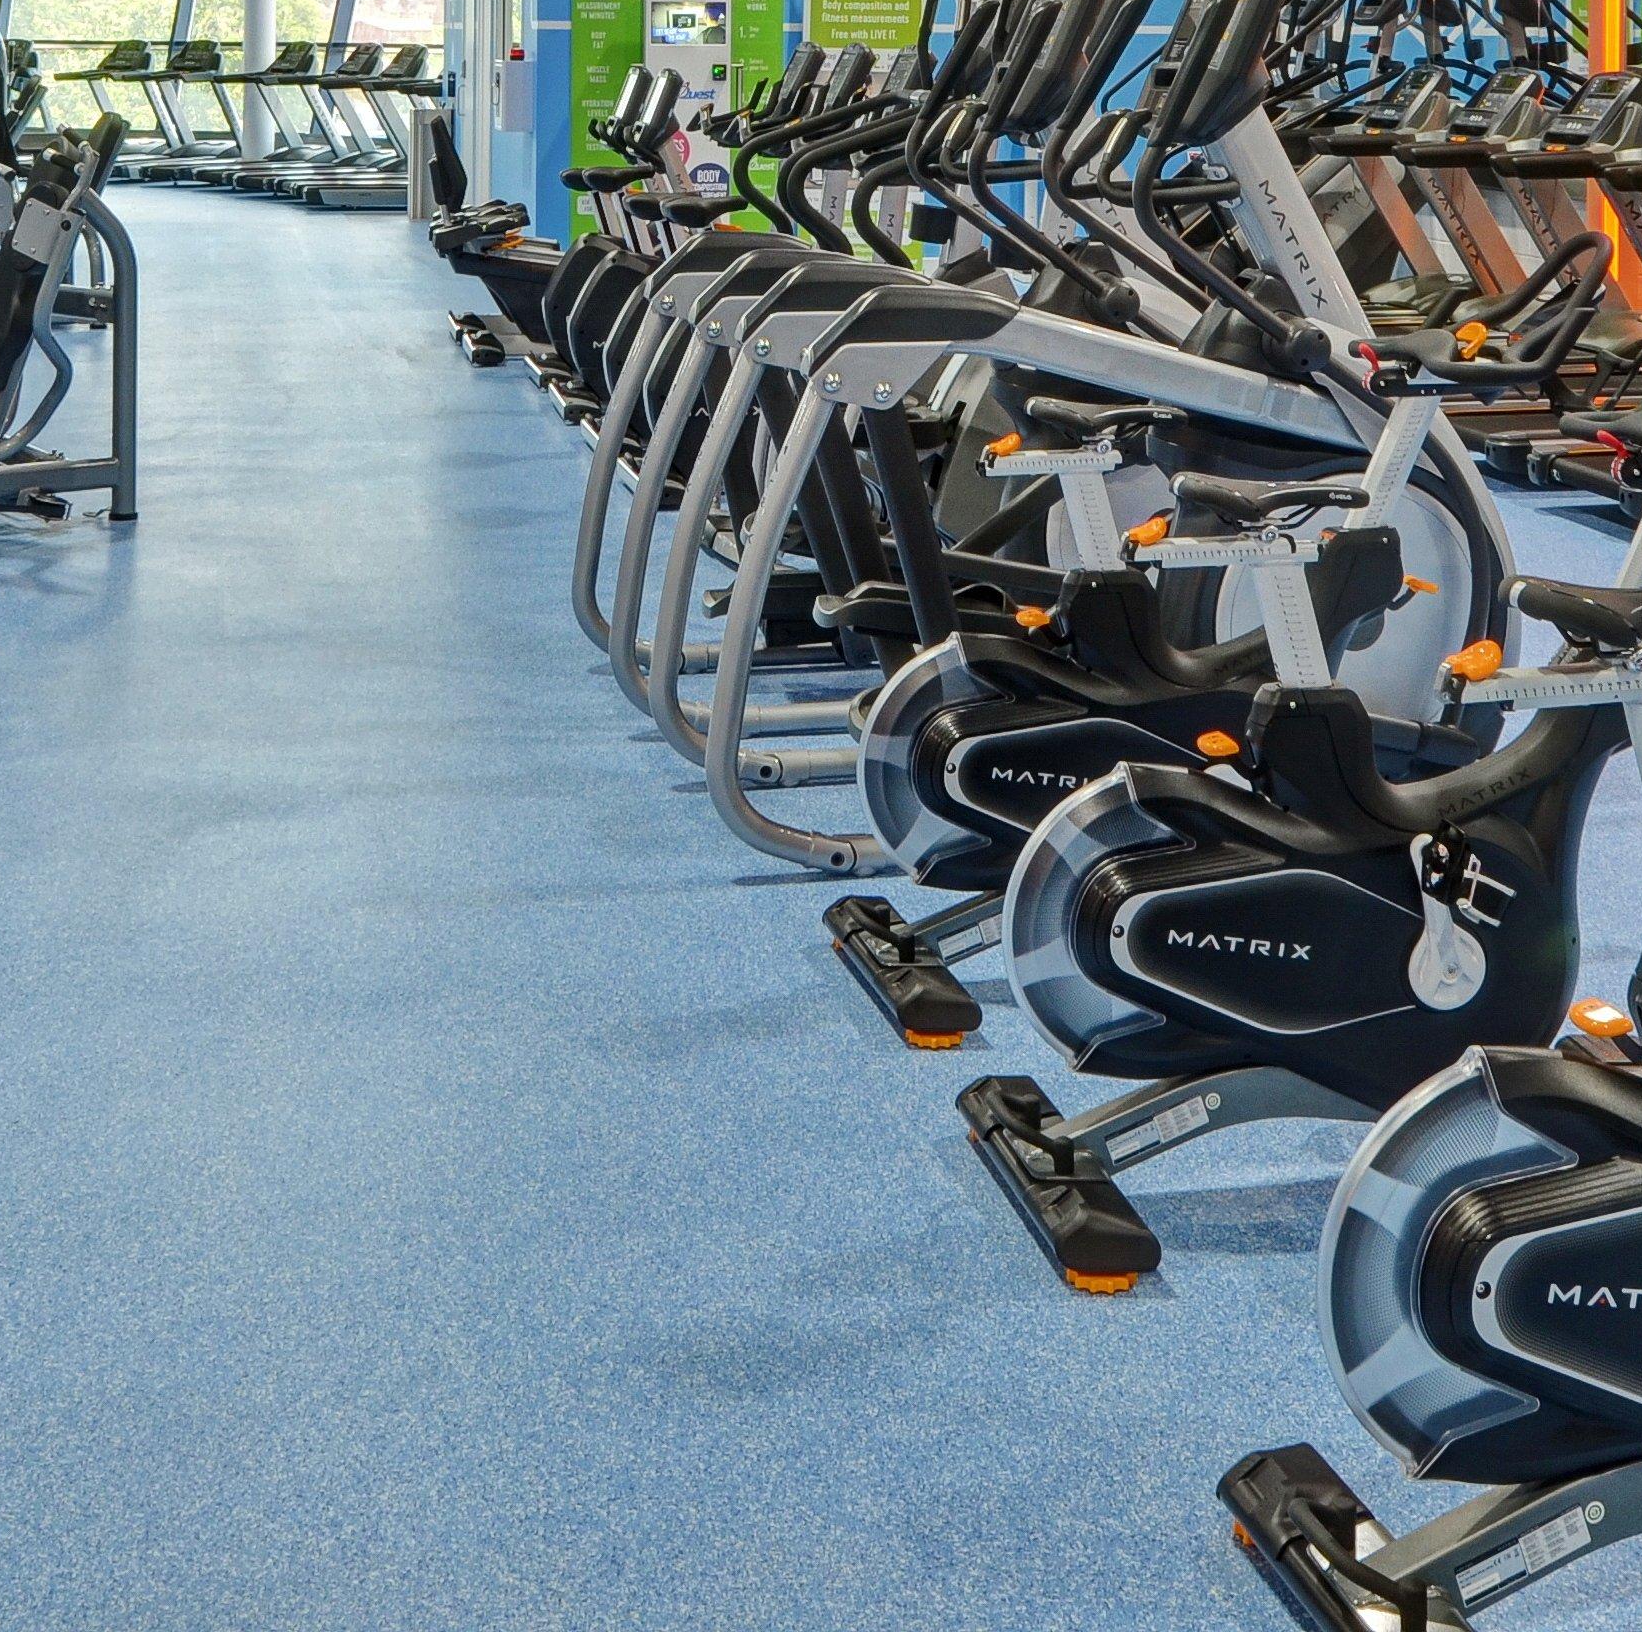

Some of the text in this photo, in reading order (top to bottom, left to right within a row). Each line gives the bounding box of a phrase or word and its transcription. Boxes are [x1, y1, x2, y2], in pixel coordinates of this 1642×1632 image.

[576, 1, 621, 10] MEASUREMENT
[822, 0, 910, 12] Body composition and
[580, 11, 589, 19] IN
[821, 12, 910, 24] fitness measurements
[591, 31, 606, 40] BODY
[831, 28, 898, 40] Free with LIVE IT.
[592, 40, 604, 49] FAT
[586, 66, 610, 74] MUSCLE
[589, 75, 607, 84] MASS
[696, 169, 720, 183] BODY
[1427, 176, 1481, 266] MATRIX
[1519, 186, 1576, 279] MATRX
[1258, 179, 1328, 310] MATRIX
[991, 766, 1089, 789] MATRI
[1437, 769, 1533, 819] MATRIX
[1167, 928, 1313, 961] MATRIX
